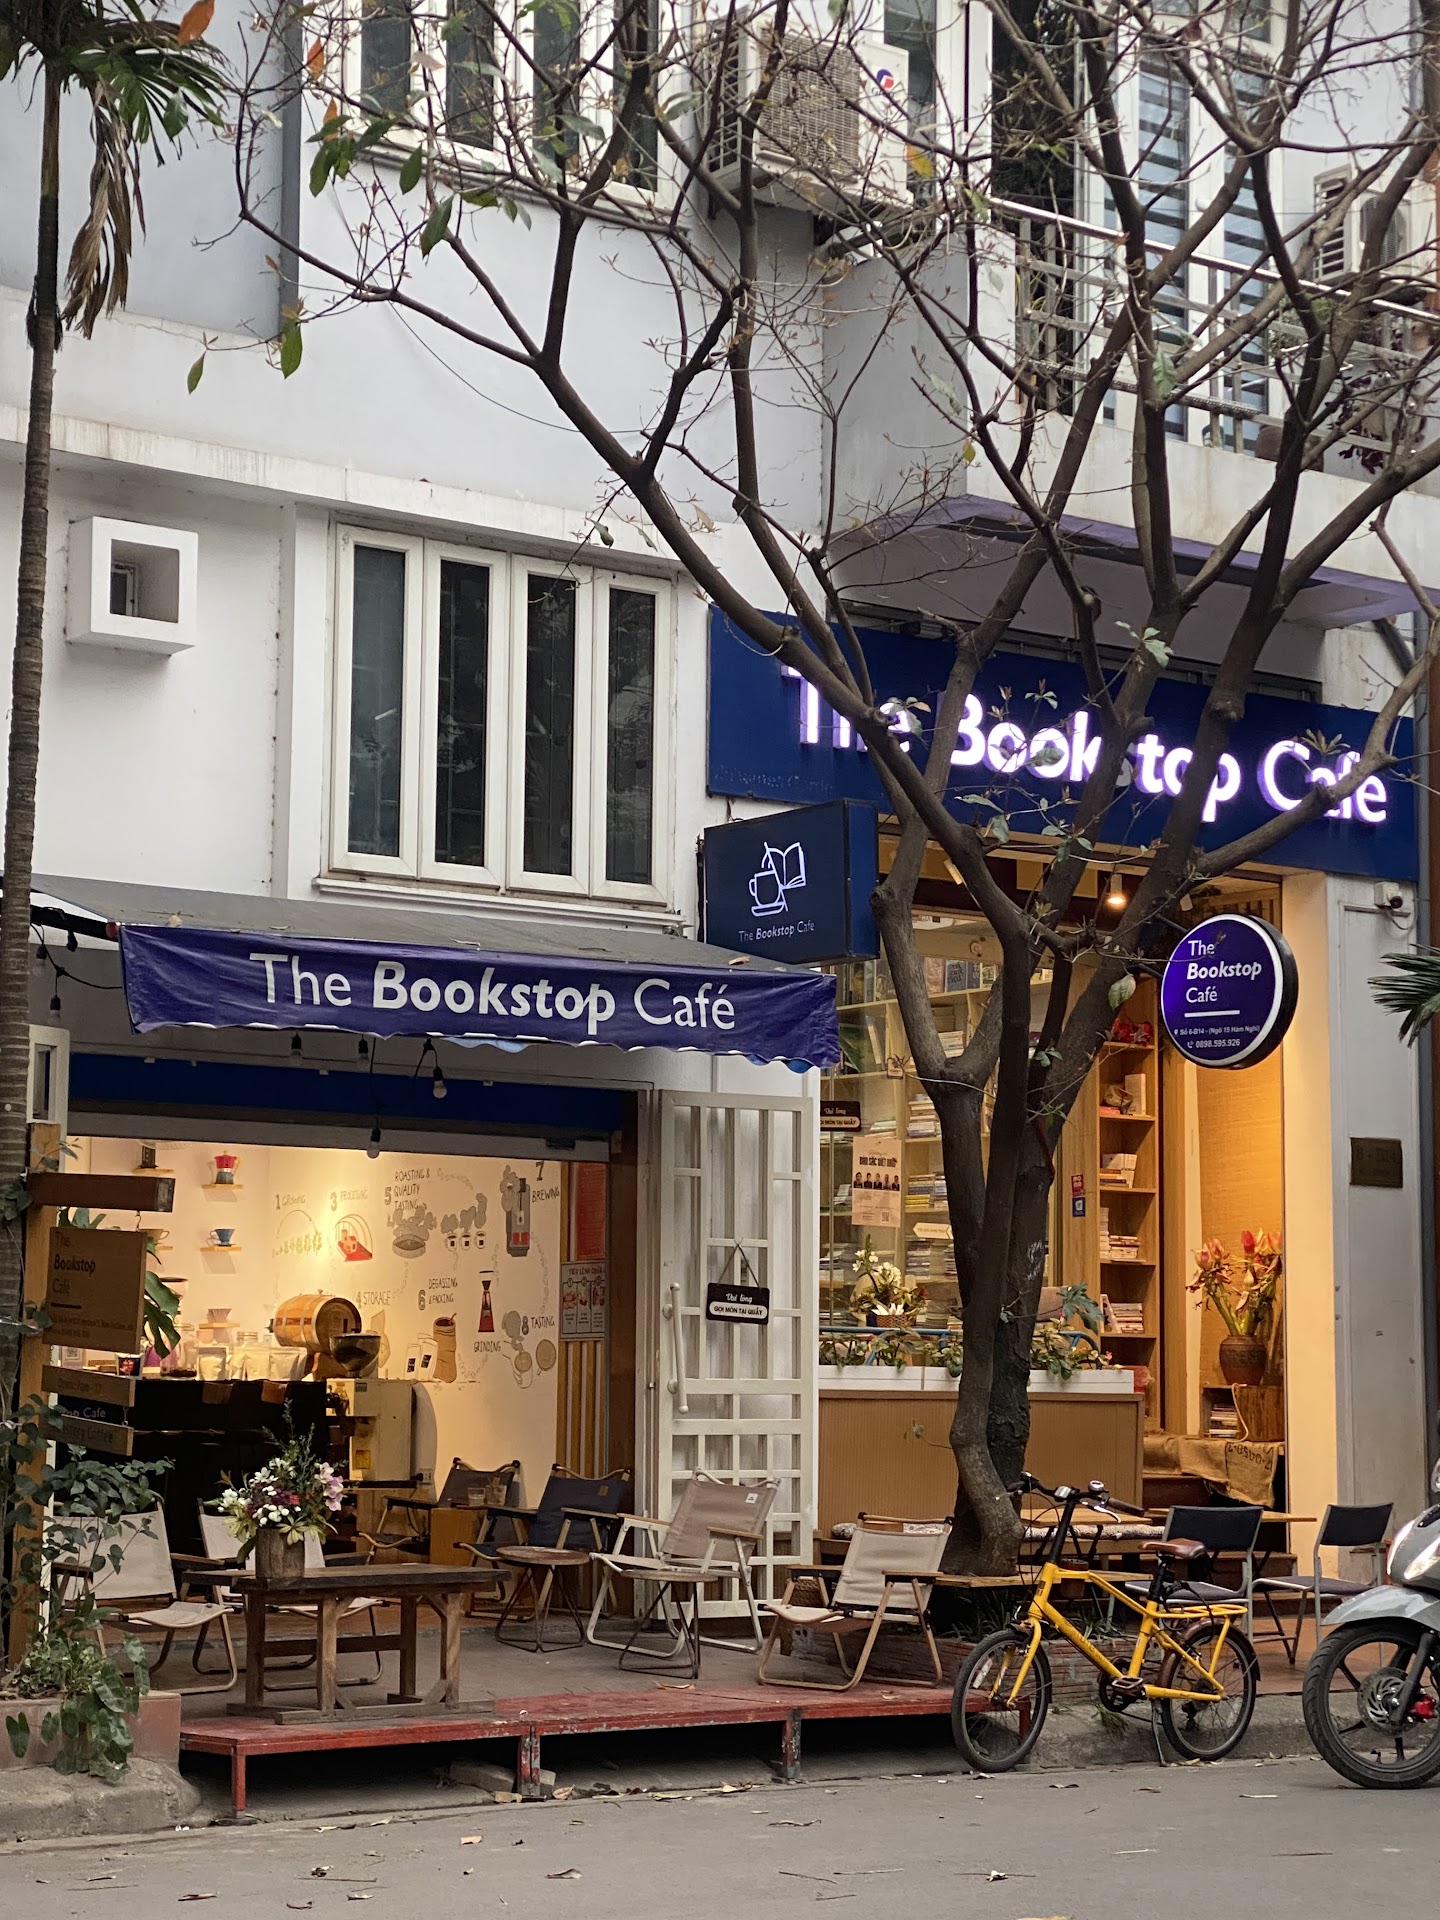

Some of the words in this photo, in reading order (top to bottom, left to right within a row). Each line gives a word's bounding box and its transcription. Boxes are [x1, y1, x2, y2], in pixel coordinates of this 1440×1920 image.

[738, 930, 753, 942] The
[756, 925, 795, 940] Bookstop
[1188, 940, 1215, 956] The
[1186, 961, 1262, 980] Bookstop
[249, 953, 352, 1007] The
[373, 960, 616, 1036] Bookstop
[634, 978, 735, 1030] Café
[1186, 986, 1218, 1003] Café
[395, 1169, 425, 1182] ROASTING
[536, 1161, 544, 1181] 7
[384, 1187, 391, 1205] 5
[394, 1183, 420, 1197] QUALITY
[532, 1186, 560, 1203] BREWING
[330, 1191, 337, 1211] 3
[54, 1231, 70, 1248] The
[53, 1253, 96, 1277] Bookstop
[363, 1291, 391, 1305] STORAGE
[418, 1289, 425, 1311] 6
[522, 1316, 529, 1335] 8
[531, 1315, 555, 1329] TASTING
[473, 1340, 502, 1353] GRINDING
